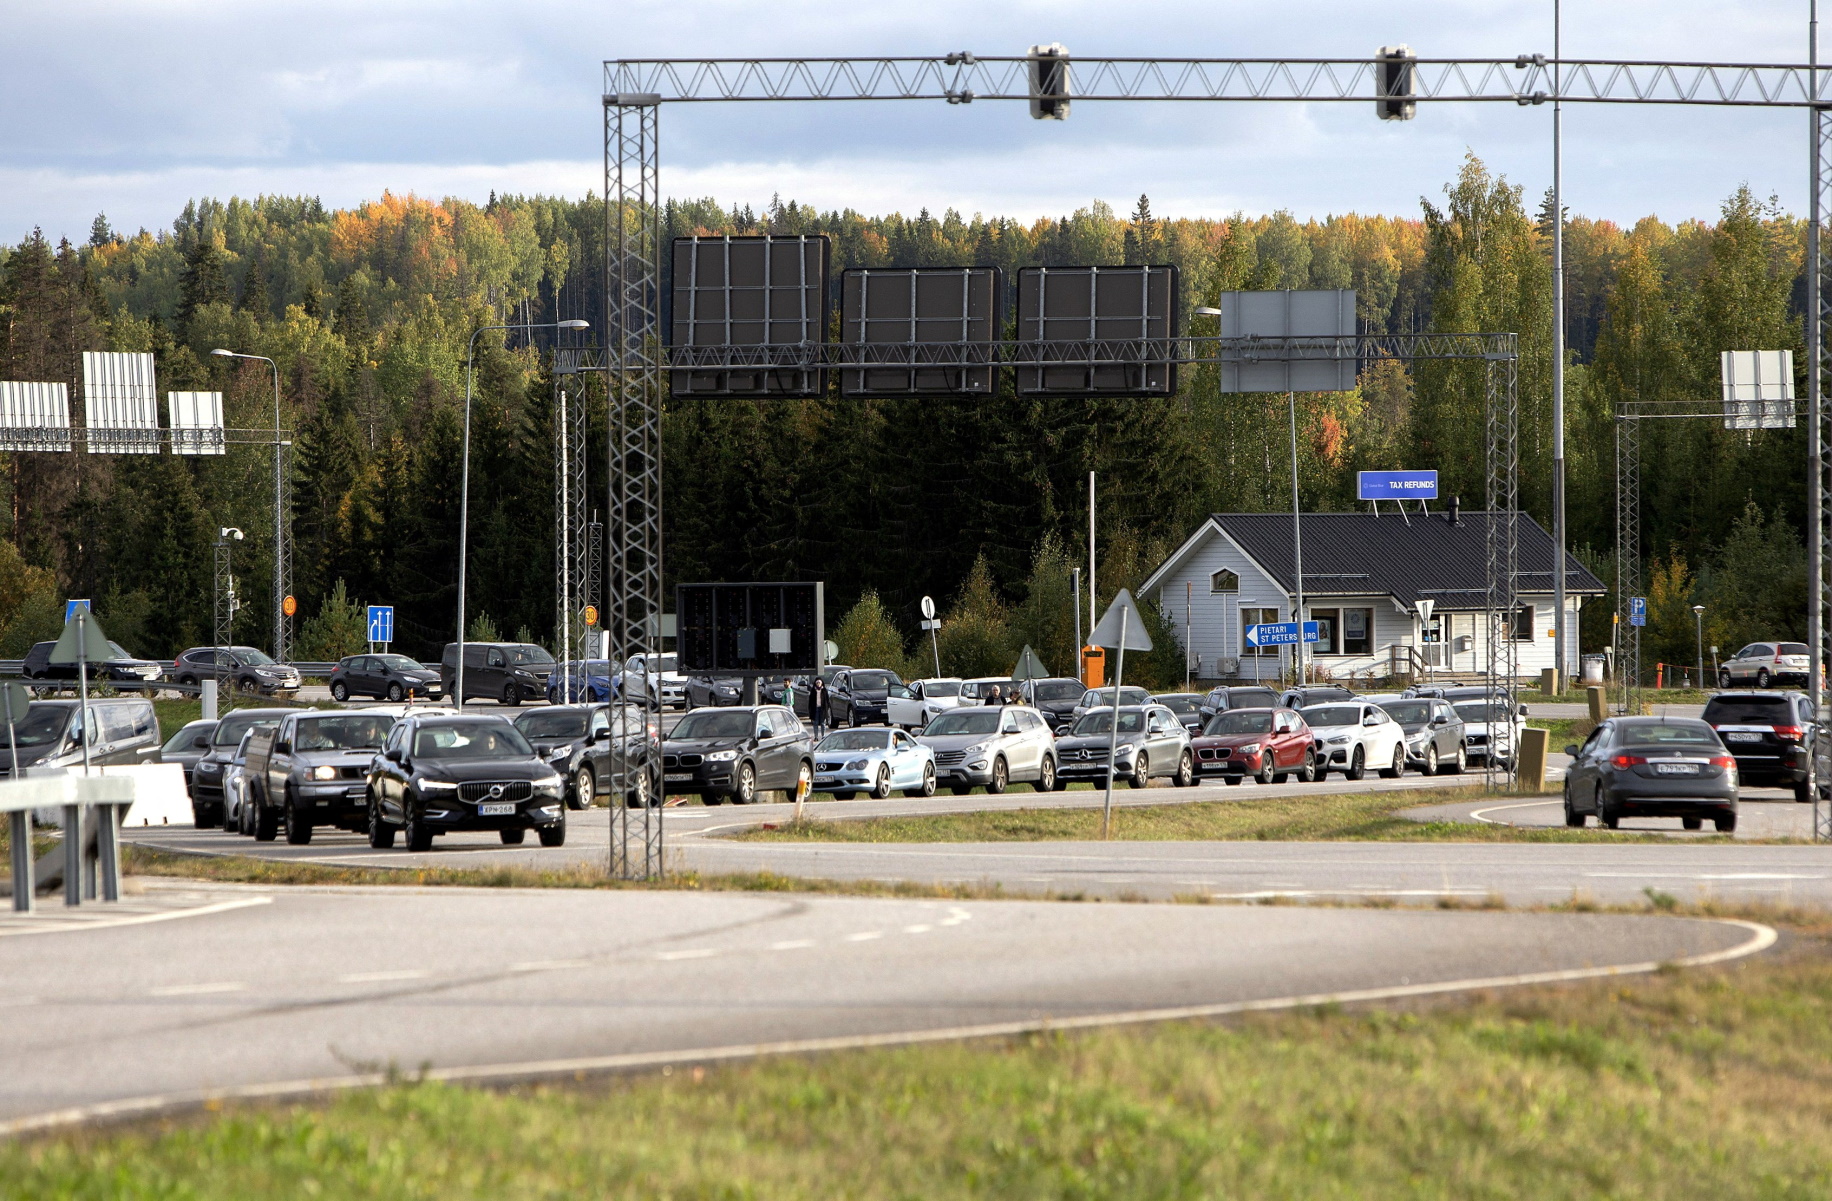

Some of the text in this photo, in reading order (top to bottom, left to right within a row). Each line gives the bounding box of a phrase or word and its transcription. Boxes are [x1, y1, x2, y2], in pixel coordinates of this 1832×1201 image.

[1389, 481, 1403, 489] TAX
[1404, 481, 1435, 489] REFUNDS
[286, 601, 294, 611] 30
[1634, 599, 1644, 614] P
[586, 611, 595, 621] 30
[1260, 625, 1287, 635] PIETARI
[1261, 632, 1317, 643] ST PETERSURG
